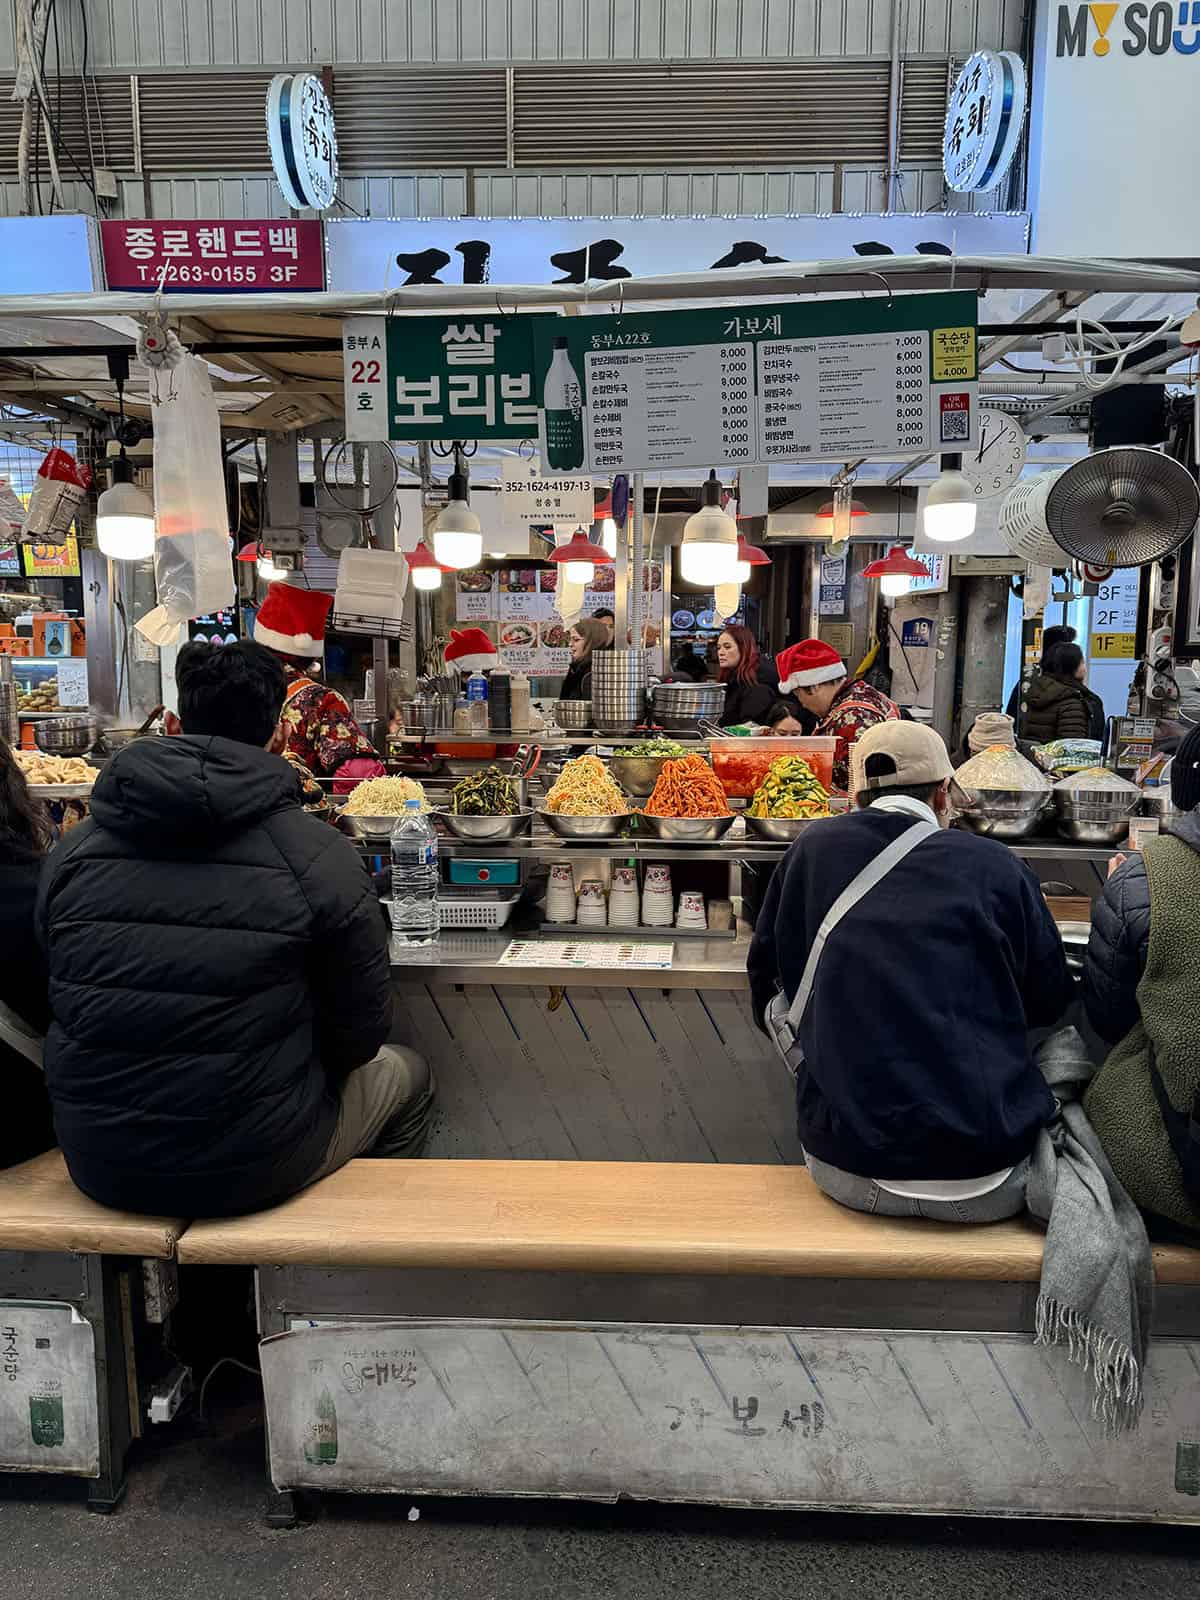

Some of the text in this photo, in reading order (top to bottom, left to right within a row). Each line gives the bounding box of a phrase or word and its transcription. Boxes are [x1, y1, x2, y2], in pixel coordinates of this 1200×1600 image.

[125, 227, 298, 259] 종로핸드백
[137, 265, 298, 282] T.2263-0155 3F
[723, 314, 782, 338] 가보세
[347, 335, 381, 350] 동부 A
[442, 323, 501, 365] 쌀
[763, 344, 792, 356] 김치만두
[896, 336, 922, 347] 7,000
[937, 331, 971, 346] 국순당
[720, 347, 746, 358] 8,000
[351, 360, 381, 383] 22
[591, 362, 747, 380] 손칼국수 7,000
[764, 359, 793, 370] 잔치국수
[896, 365, 922, 376] 8,000
[944, 367, 967, 377] 4,000
[721, 377, 747, 388] 8,000
[764, 380, 922, 399] 비빔국수 8,000
[357, 392, 374, 411] 호
[592, 391, 748, 409] 손칼수제비 8,000
[765, 402, 786, 413] 콩국수
[942, 401, 967, 409] MENU
[593, 412, 622, 423] 손수제비
[765, 408, 923, 427] 물냉면 8,000
[978, 414, 991, 428] 12
[765, 422, 923, 441] 비빔냉면 8,000
[1008, 430, 1017, 443] 2
[897, 437, 923, 448] 7,000
[723, 447, 749, 458] 7,000
[1012, 447, 1021, 460] 3
[1006, 463, 1013, 474] 4
[505, 481, 591, 492] 352-1624-4197-13
[974, 482, 983, 495] 6
[993, 476, 1001, 489] 5
[1099, 585, 1121, 601] 3F
[1097, 610, 1119, 625] 2F
[915, 622, 928, 634] 19
[1097, 636, 1115, 651] 1F
[1, 1327, 19, 1381] 국순당
[362, 1362, 417, 1388] 대박
